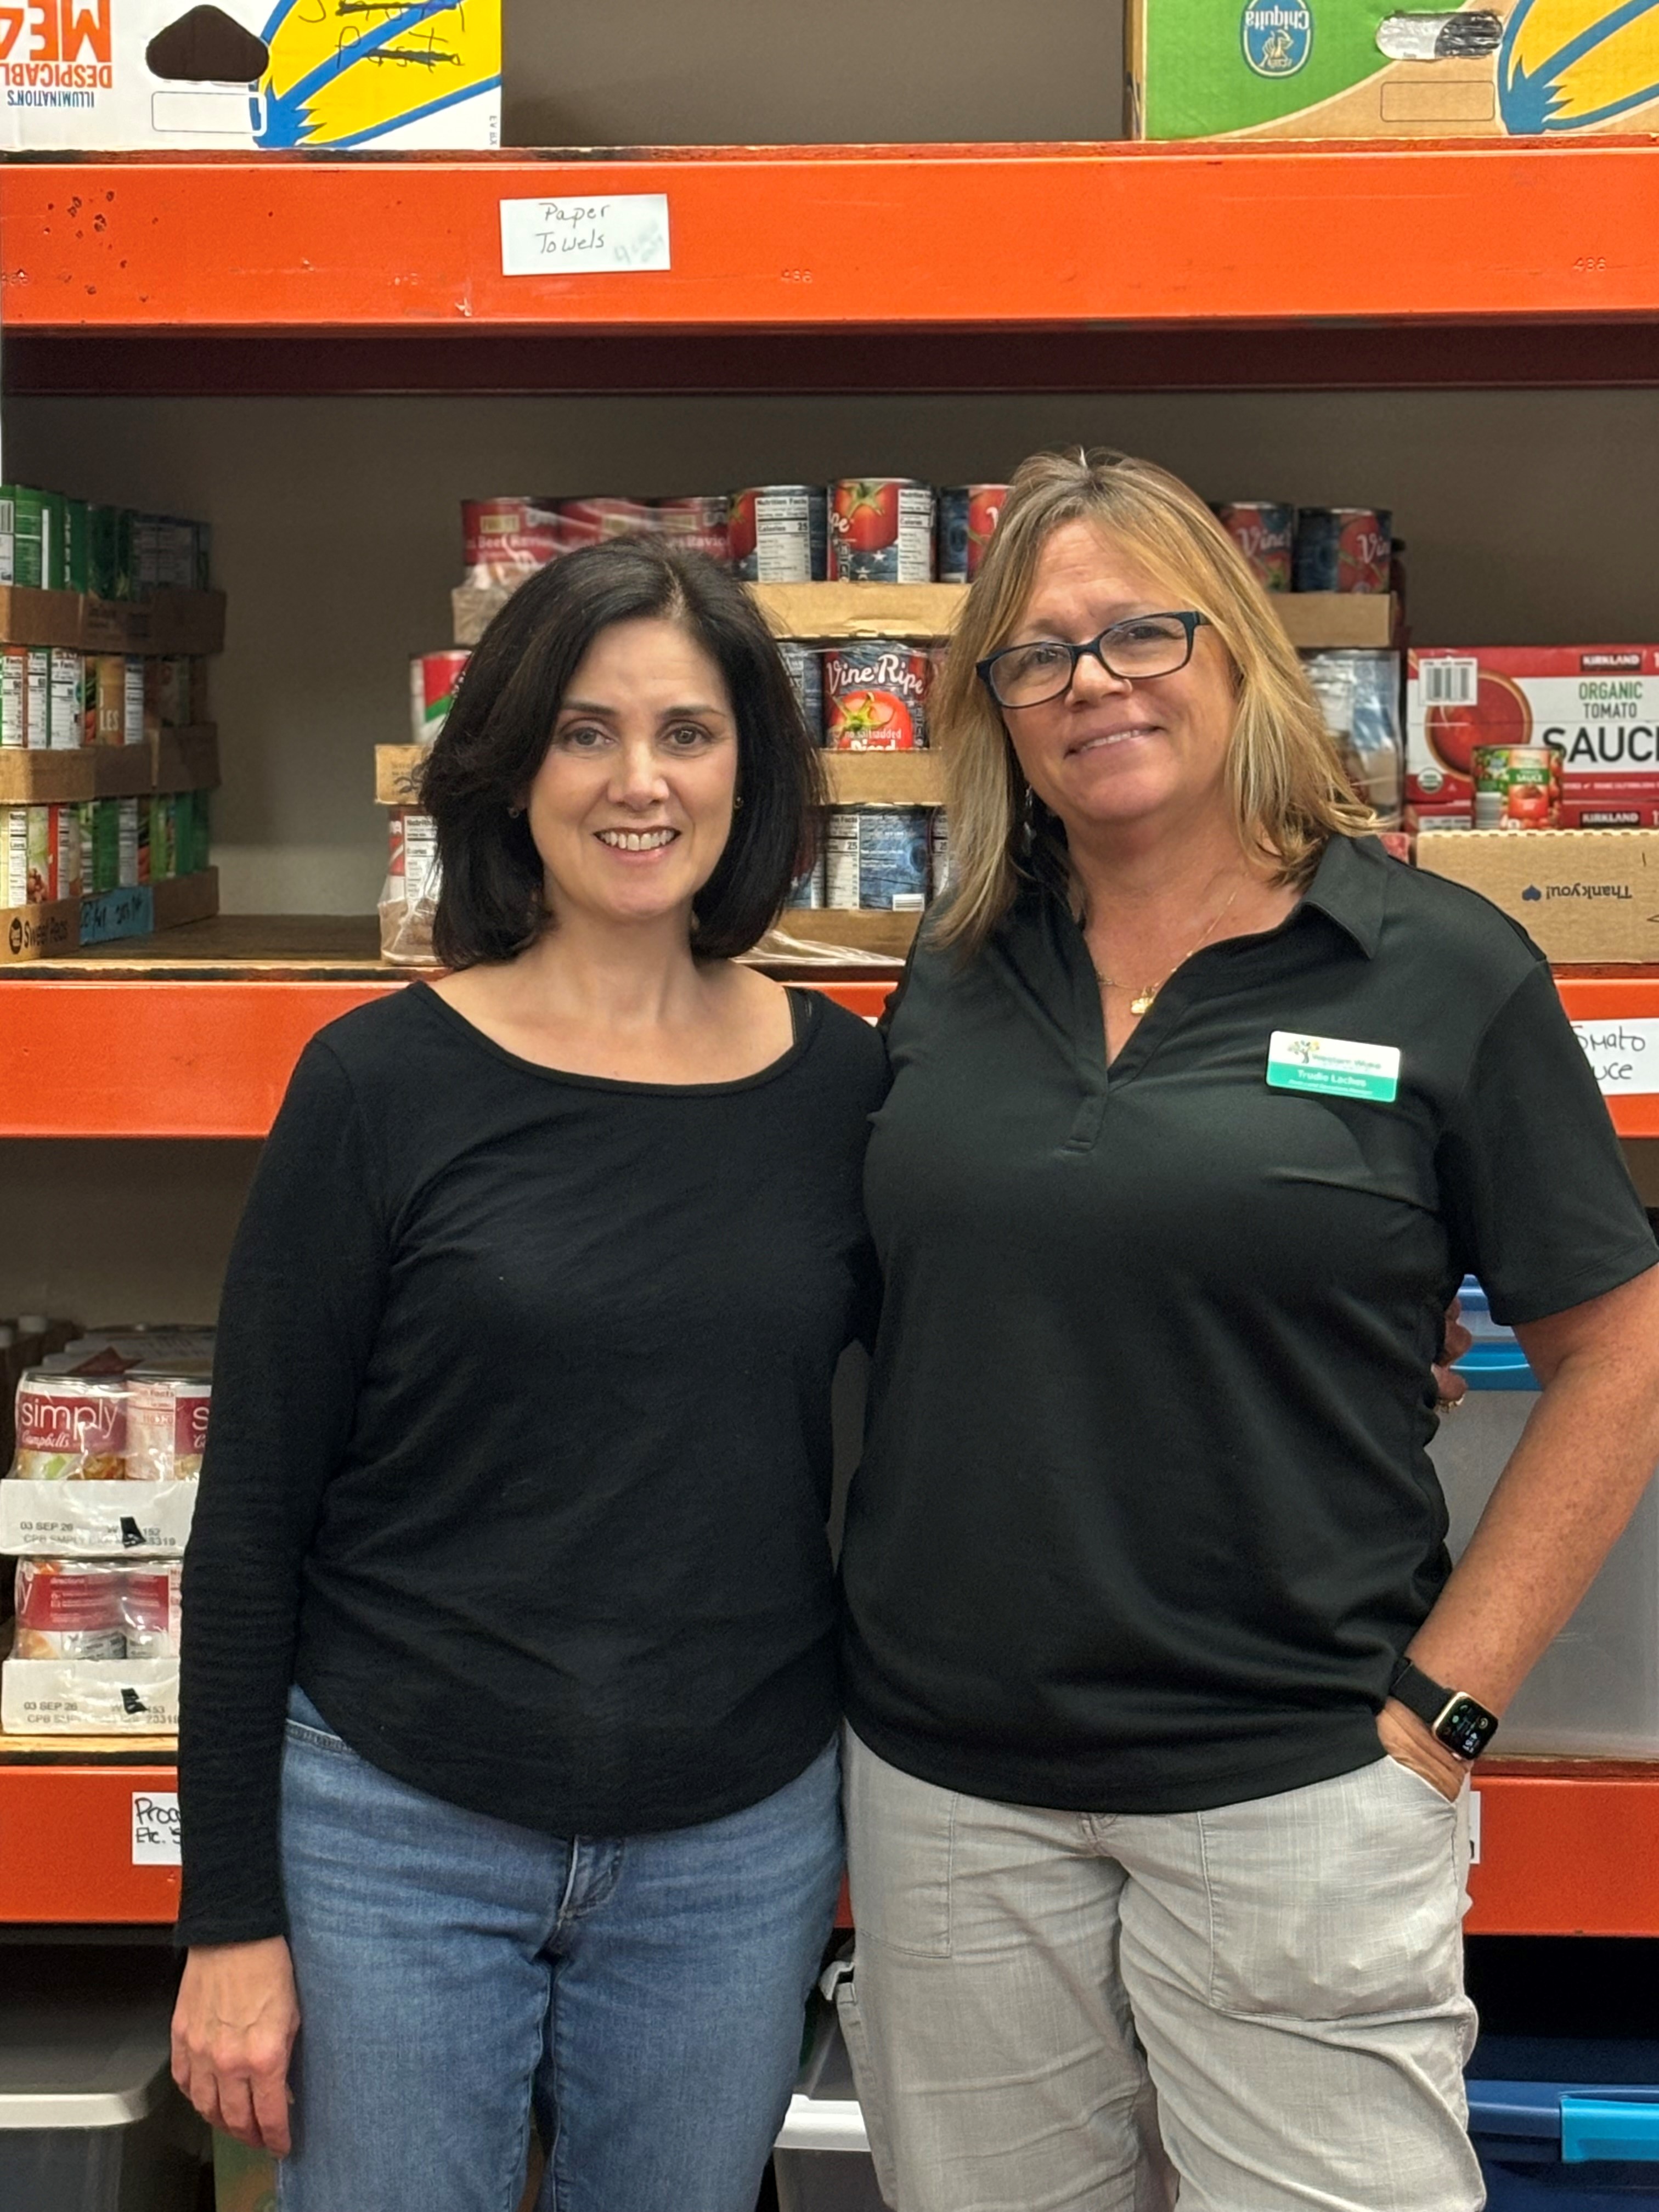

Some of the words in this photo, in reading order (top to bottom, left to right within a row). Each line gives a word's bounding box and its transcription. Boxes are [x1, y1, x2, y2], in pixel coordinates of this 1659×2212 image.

[1245, 5, 1310, 30] Chiquita
[7, 89, 94, 108] ILLUMINATION'S
[539, 202, 610, 229] Paper
[535, 229, 605, 254] Towels
[1583, 654, 1640, 666] KIRKLAND
[878, 653, 924, 695] Ripe
[1579, 681, 1643, 700] ORGANIC
[1583, 702, 1638, 719] TOMATO
[1543, 726, 1659, 763] SAUC
[1582, 813, 1639, 823] KIRKLAND
[1572, 1025, 1645, 1052] omato
[21, 1398, 119, 1440] simply
[36, 1522, 58, 1530] SEP
[40, 1702, 62, 1711] SEP
